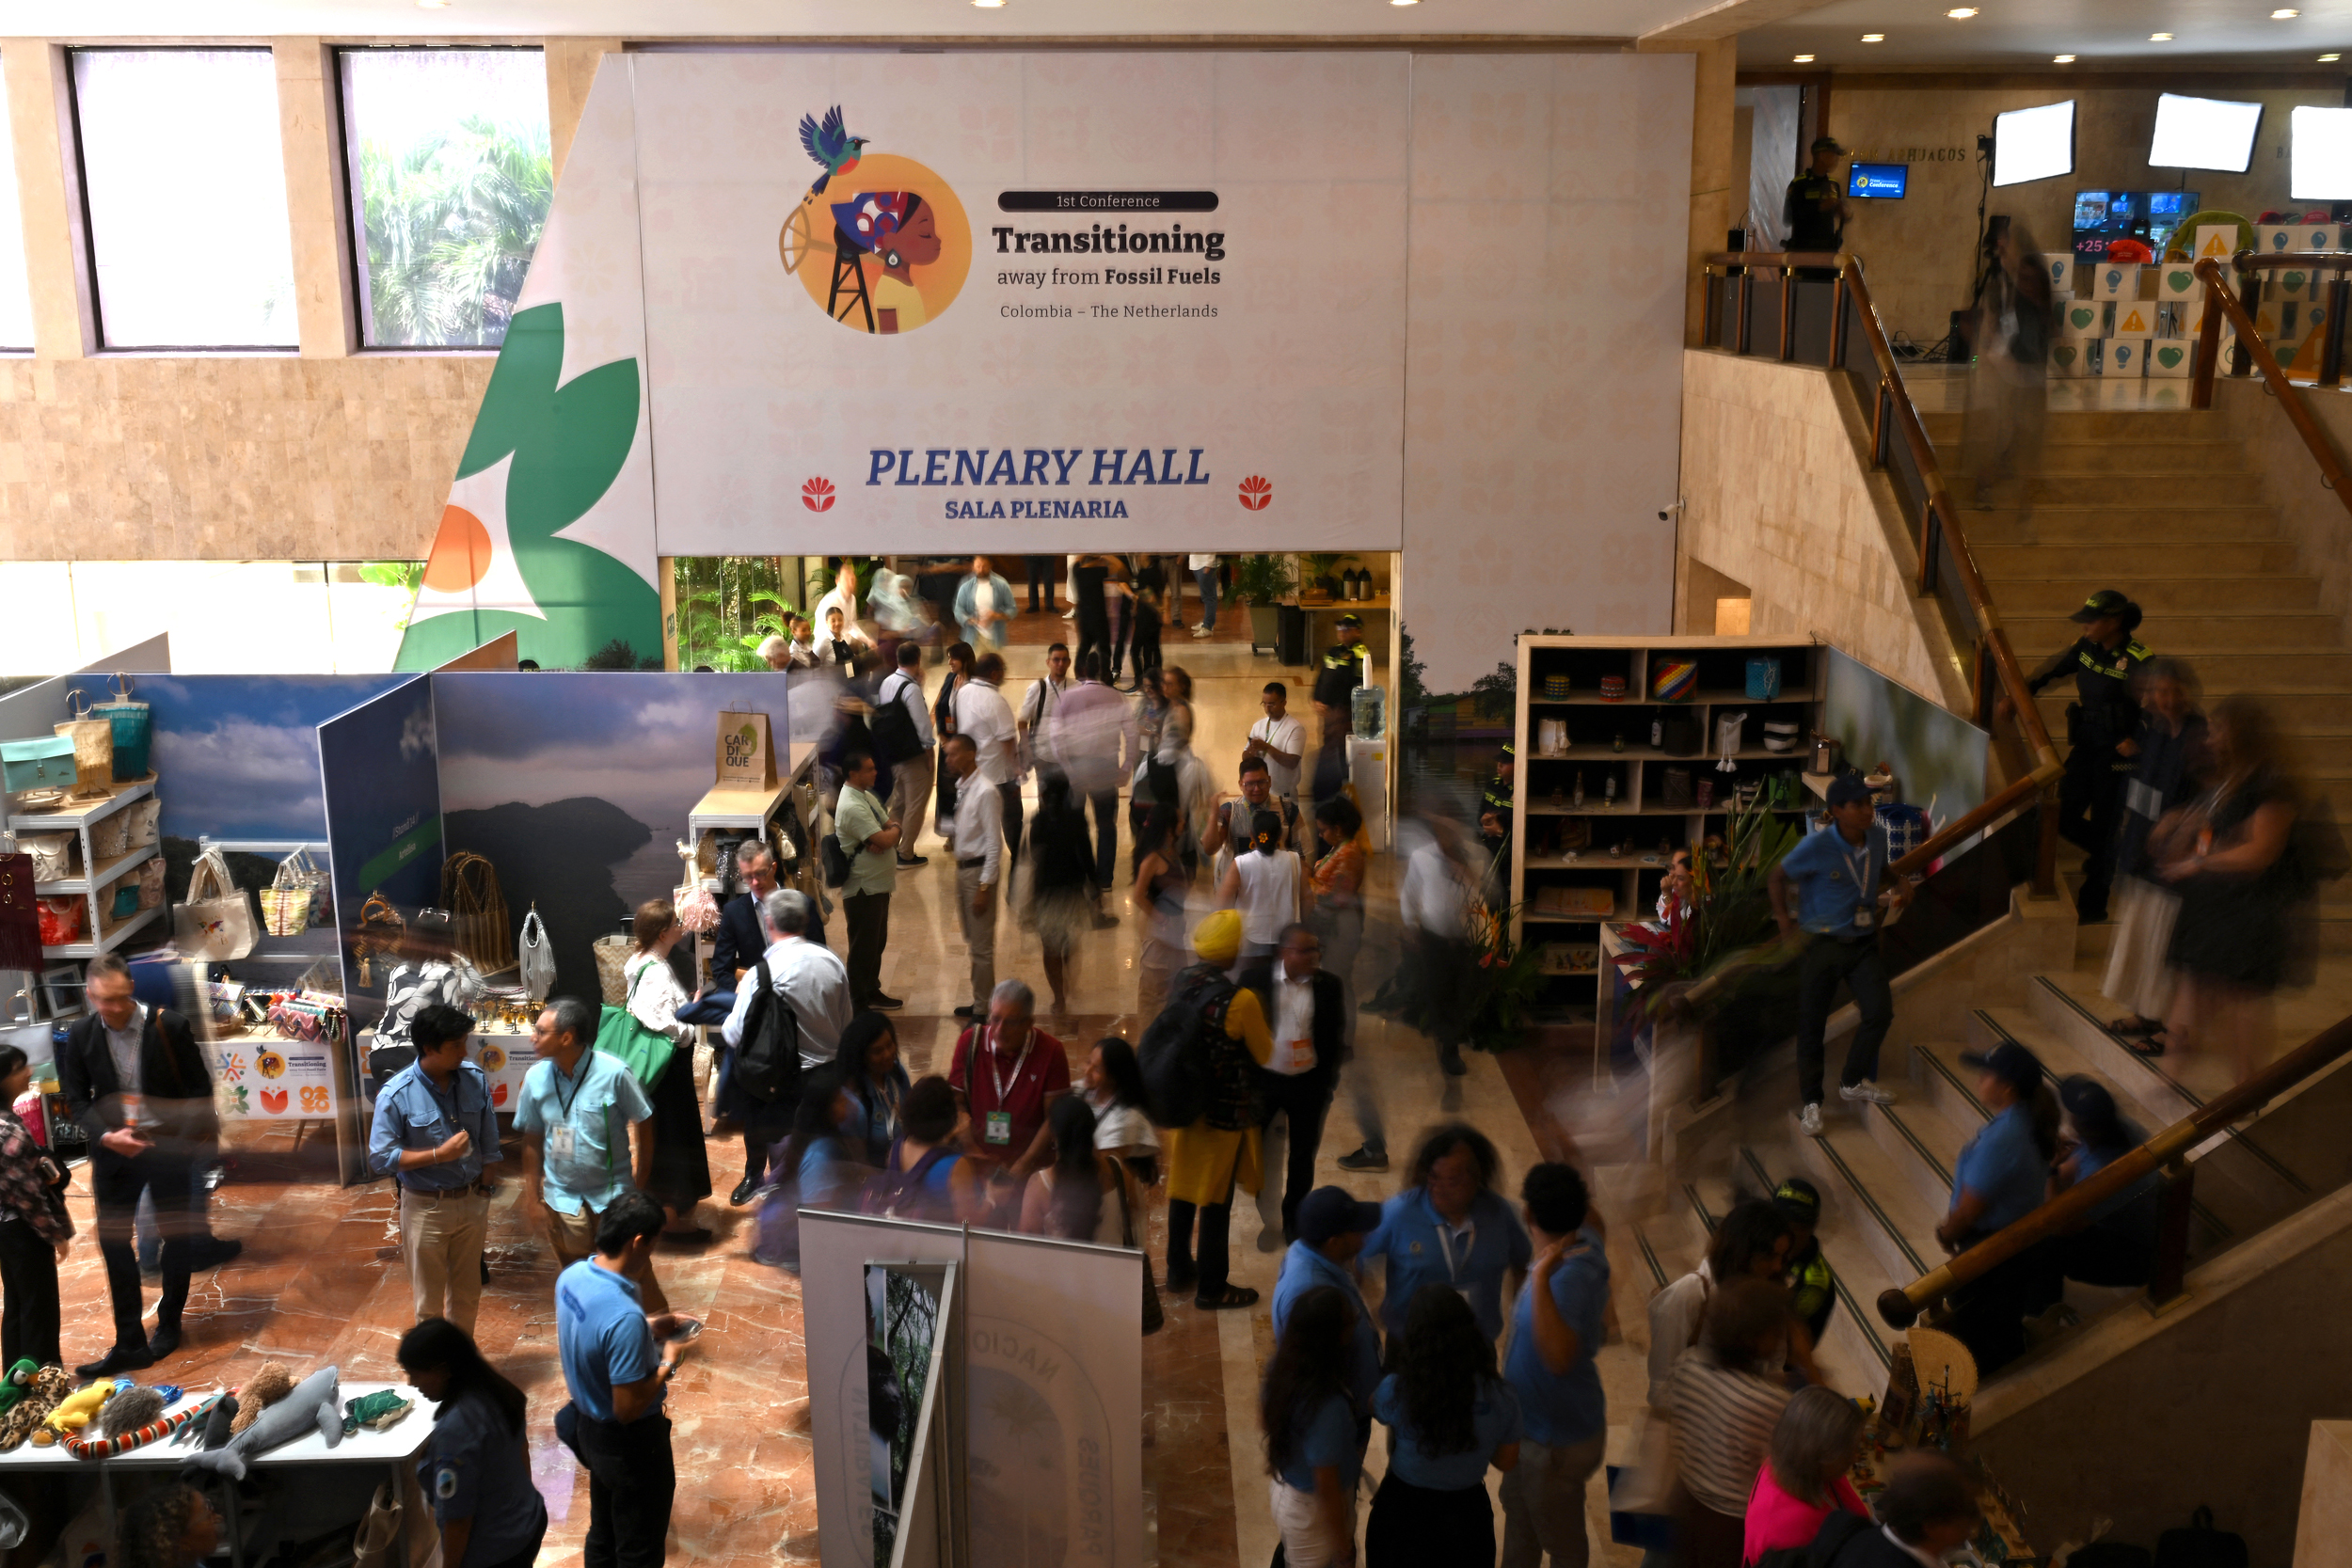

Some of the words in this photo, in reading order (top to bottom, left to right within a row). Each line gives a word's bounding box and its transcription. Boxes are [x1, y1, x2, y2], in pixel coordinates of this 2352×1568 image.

[1886, 148, 1966, 162] ARHUACOS
[1056, 195, 1076, 207] 1st
[1079, 194, 1160, 208] Conference
[992, 225, 1226, 261] Transitioning
[997, 270, 1046, 290] away
[1051, 267, 1100, 285] from
[1104, 267, 1163, 285] Fossil
[1167, 267, 1221, 285] Fuels
[1000, 304, 1073, 318] Colombia
[1090, 304, 1119, 318] The
[1123, 304, 1218, 318] Netherlands
[866, 448, 1082, 487] PLENARY
[1089, 448, 1211, 486] HALL
[945, 500, 1006, 519] SALA
[1010, 500, 1129, 519] PLENARIA
[724, 735, 749, 746] CAR
[726, 745, 739, 756] DI
[725, 756, 750, 768] QUE
